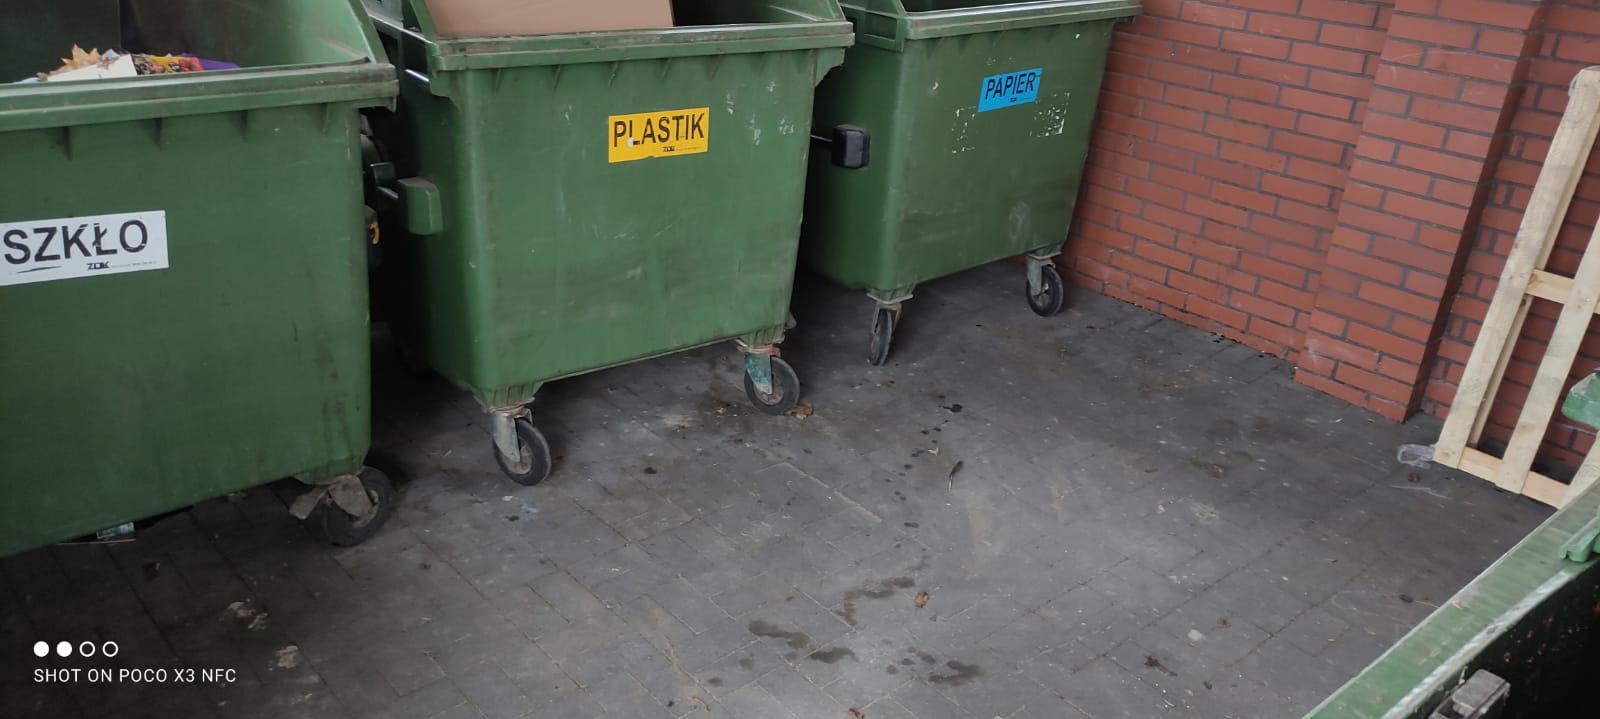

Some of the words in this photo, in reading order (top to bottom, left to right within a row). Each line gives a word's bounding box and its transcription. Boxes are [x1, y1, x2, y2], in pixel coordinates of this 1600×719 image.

[985, 72, 1036, 100] PAPIER
[614, 113, 705, 147] PLASTIK
[3, 219, 148, 264] SZKŁO
